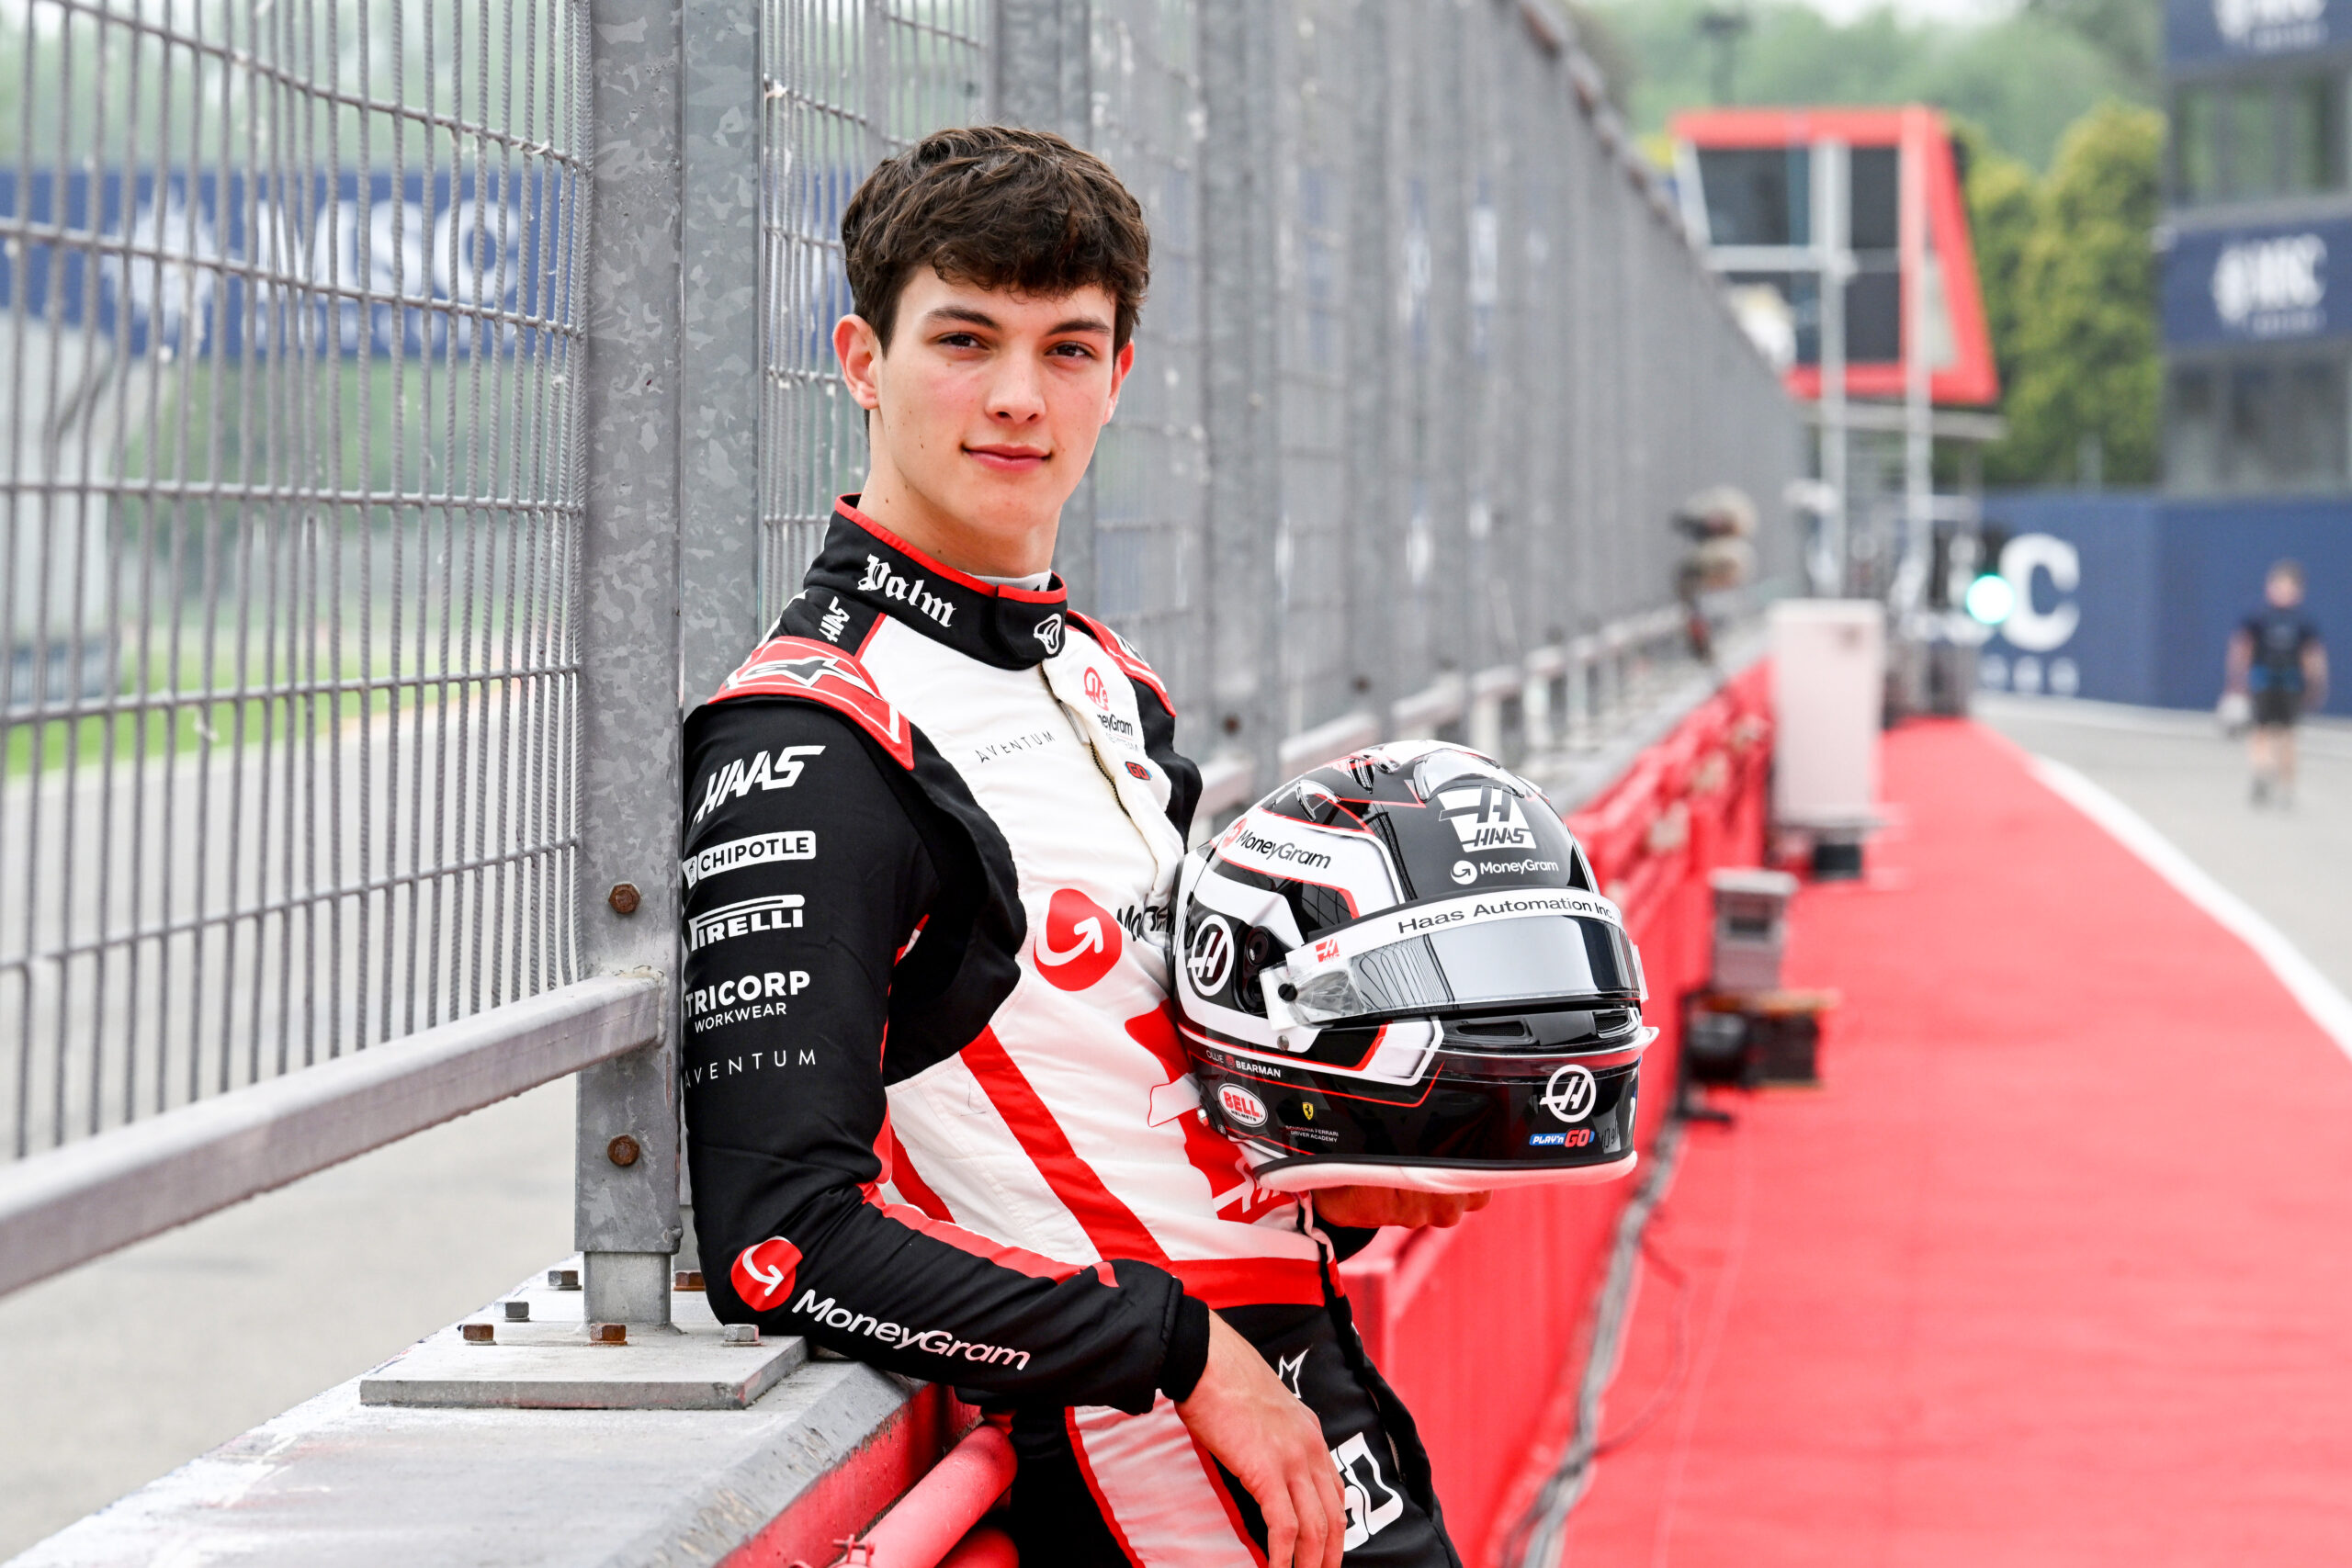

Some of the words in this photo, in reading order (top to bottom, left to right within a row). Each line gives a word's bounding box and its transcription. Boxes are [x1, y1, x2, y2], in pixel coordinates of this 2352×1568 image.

[857, 553, 957, 628] Palm
[819, 596, 850, 642] HAAS
[975, 730, 1056, 763] AVENTUM
[691, 745, 826, 828] HAAS
[701, 837, 809, 872] CHIPOTLE
[1236, 829, 1331, 869] MoneyGram
[1461, 828, 1532, 847] HAAS
[1480, 859, 1559, 874] MoneyGram
[689, 895, 805, 952] PIRELLI
[1398, 910, 1464, 933] Haas
[1473, 897, 1592, 917] Automation
[685, 970, 810, 1018] TRICORP
[695, 1002, 787, 1033] WORKWEAR
[684, 1049, 816, 1089] AVENTUM
[1236, 1060, 1281, 1077] BEARMAN
[1223, 1090, 1261, 1118] BELL
[1310, 1134, 1338, 1143] ACADEMY
[1564, 1129, 1590, 1148] GO
[791, 1289, 1031, 1371] MoneyGram
